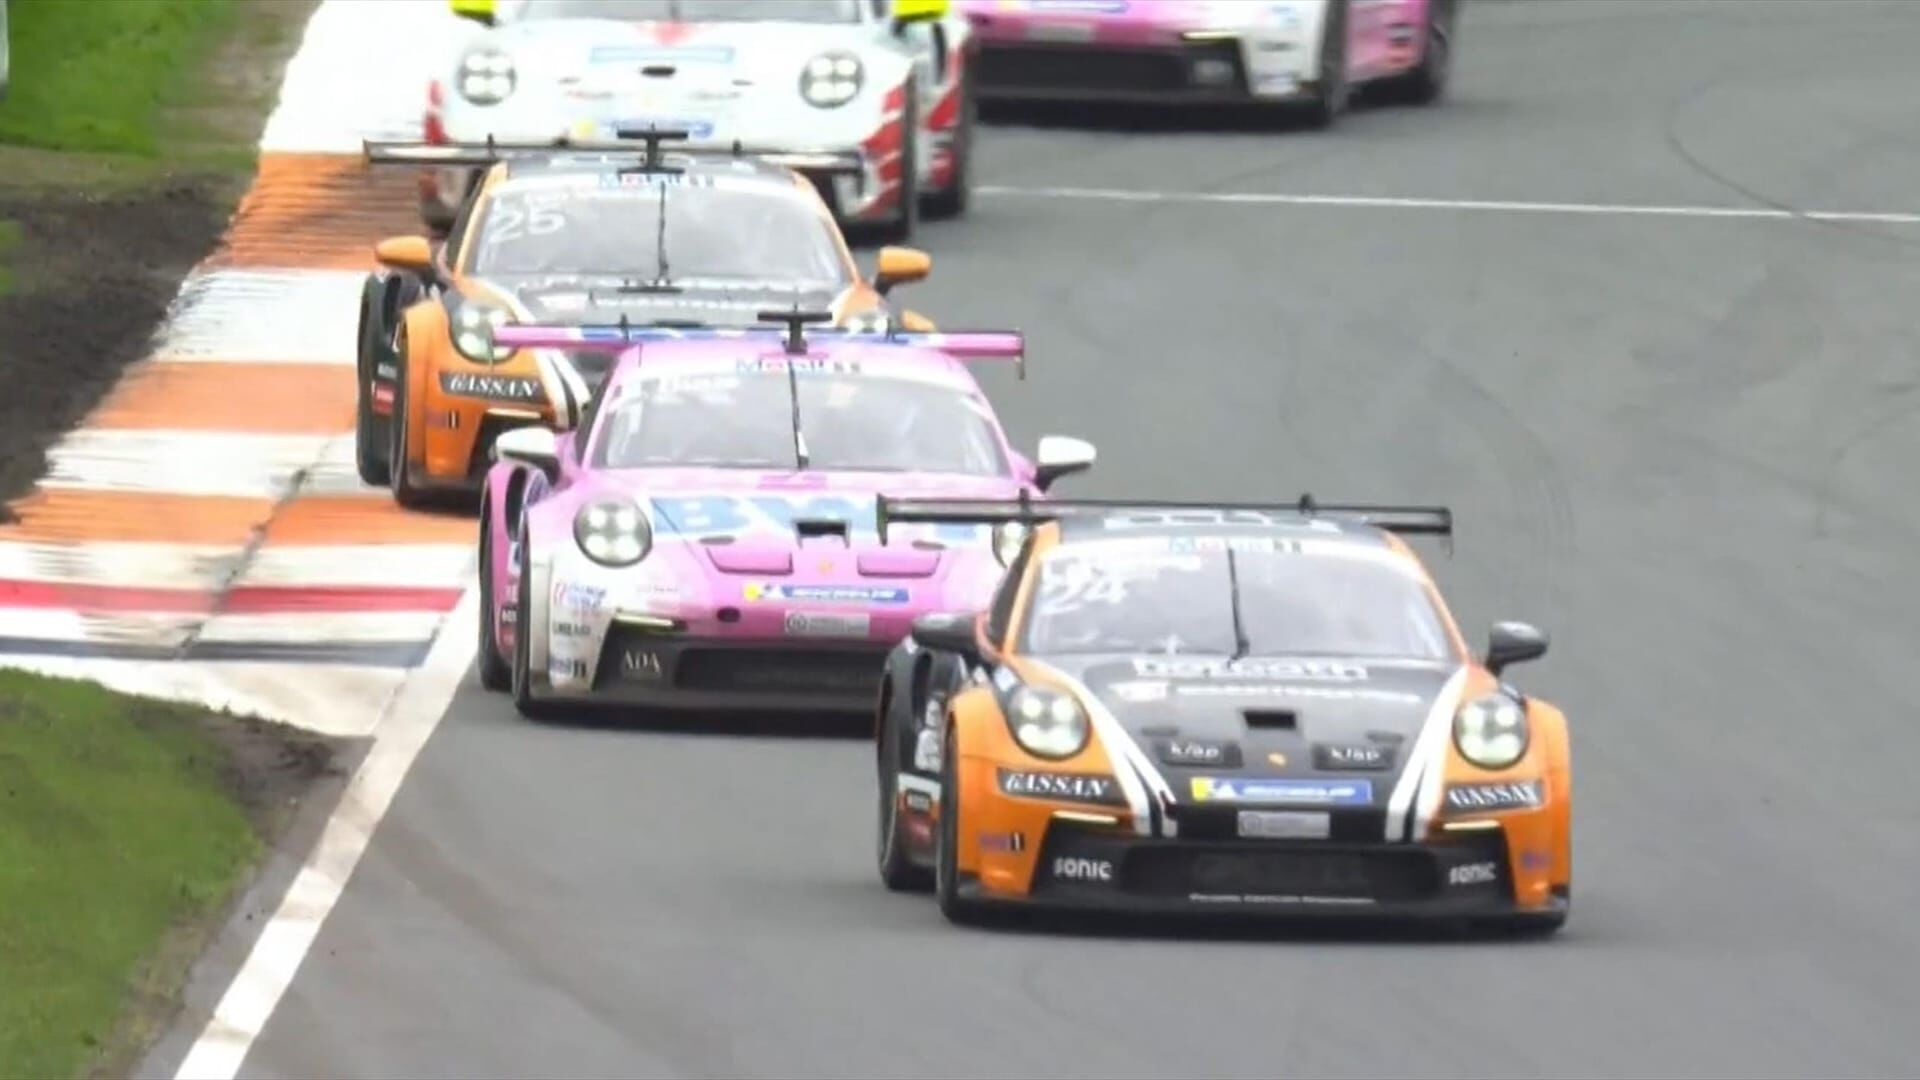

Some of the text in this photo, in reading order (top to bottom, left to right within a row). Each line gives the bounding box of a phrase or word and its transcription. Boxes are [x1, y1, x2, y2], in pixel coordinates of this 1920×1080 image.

[487, 199, 566, 243] 25
[1039, 565, 1128, 615] 24
[622, 650, 660, 673] ADA
[1004, 772, 1107, 797] GASSAN
